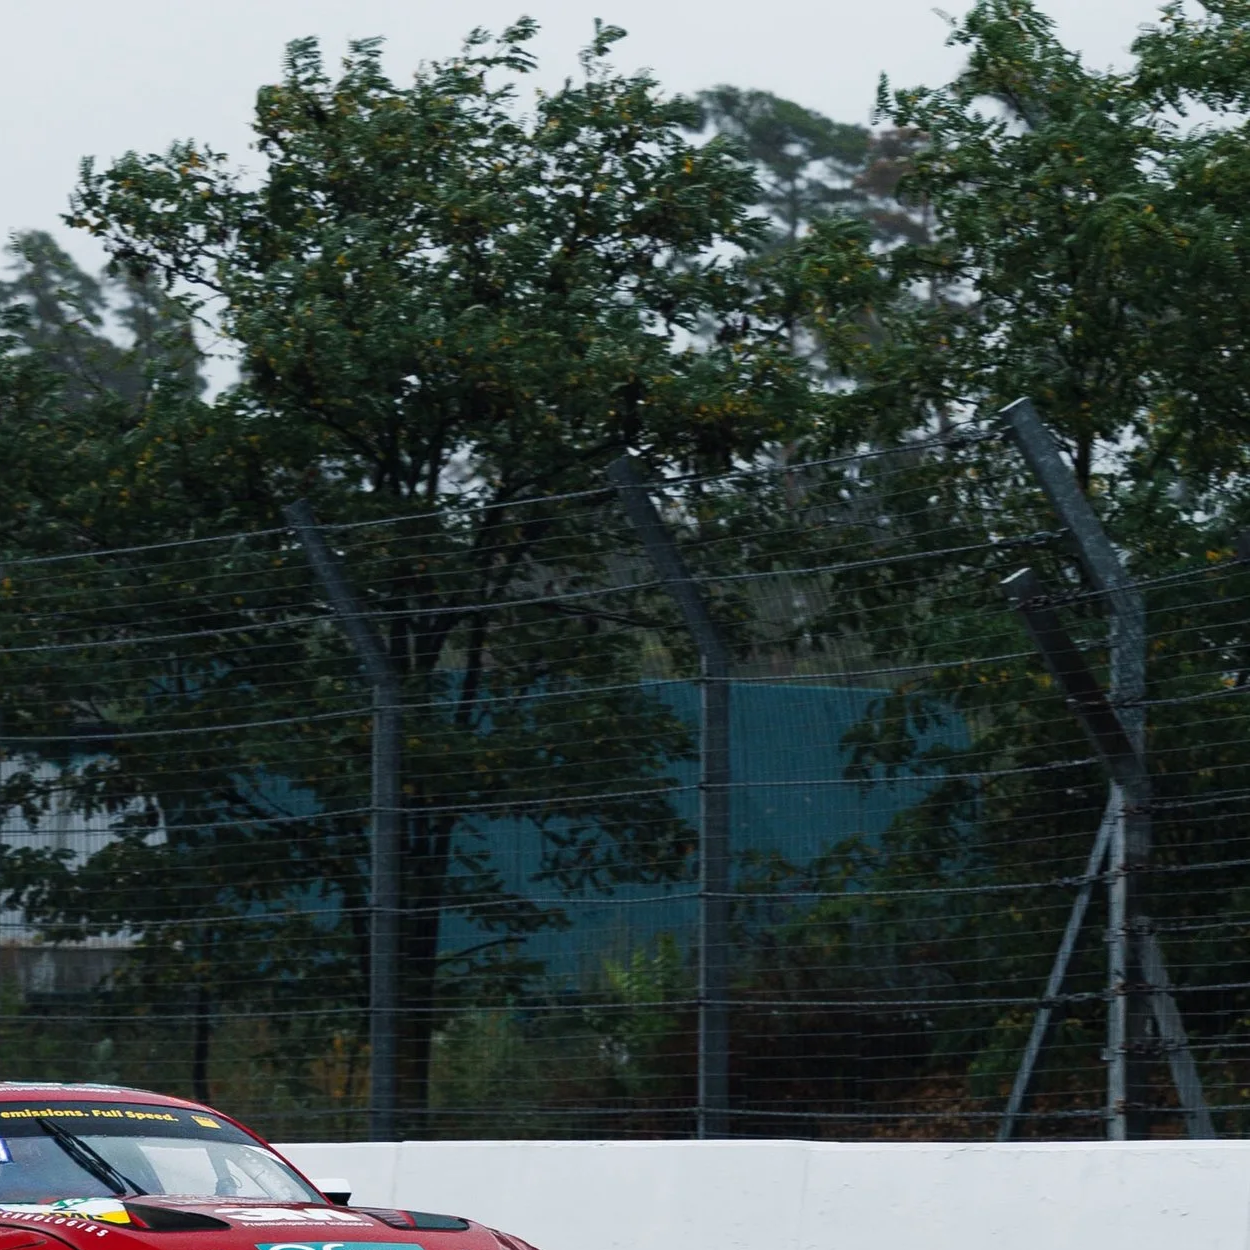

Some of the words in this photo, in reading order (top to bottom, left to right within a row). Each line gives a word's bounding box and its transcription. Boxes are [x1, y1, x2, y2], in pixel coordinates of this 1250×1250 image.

[0, 1108, 89, 1118] emissions.
[92, 1109, 124, 1118] Full
[125, 1110, 179, 1122] Speed.
